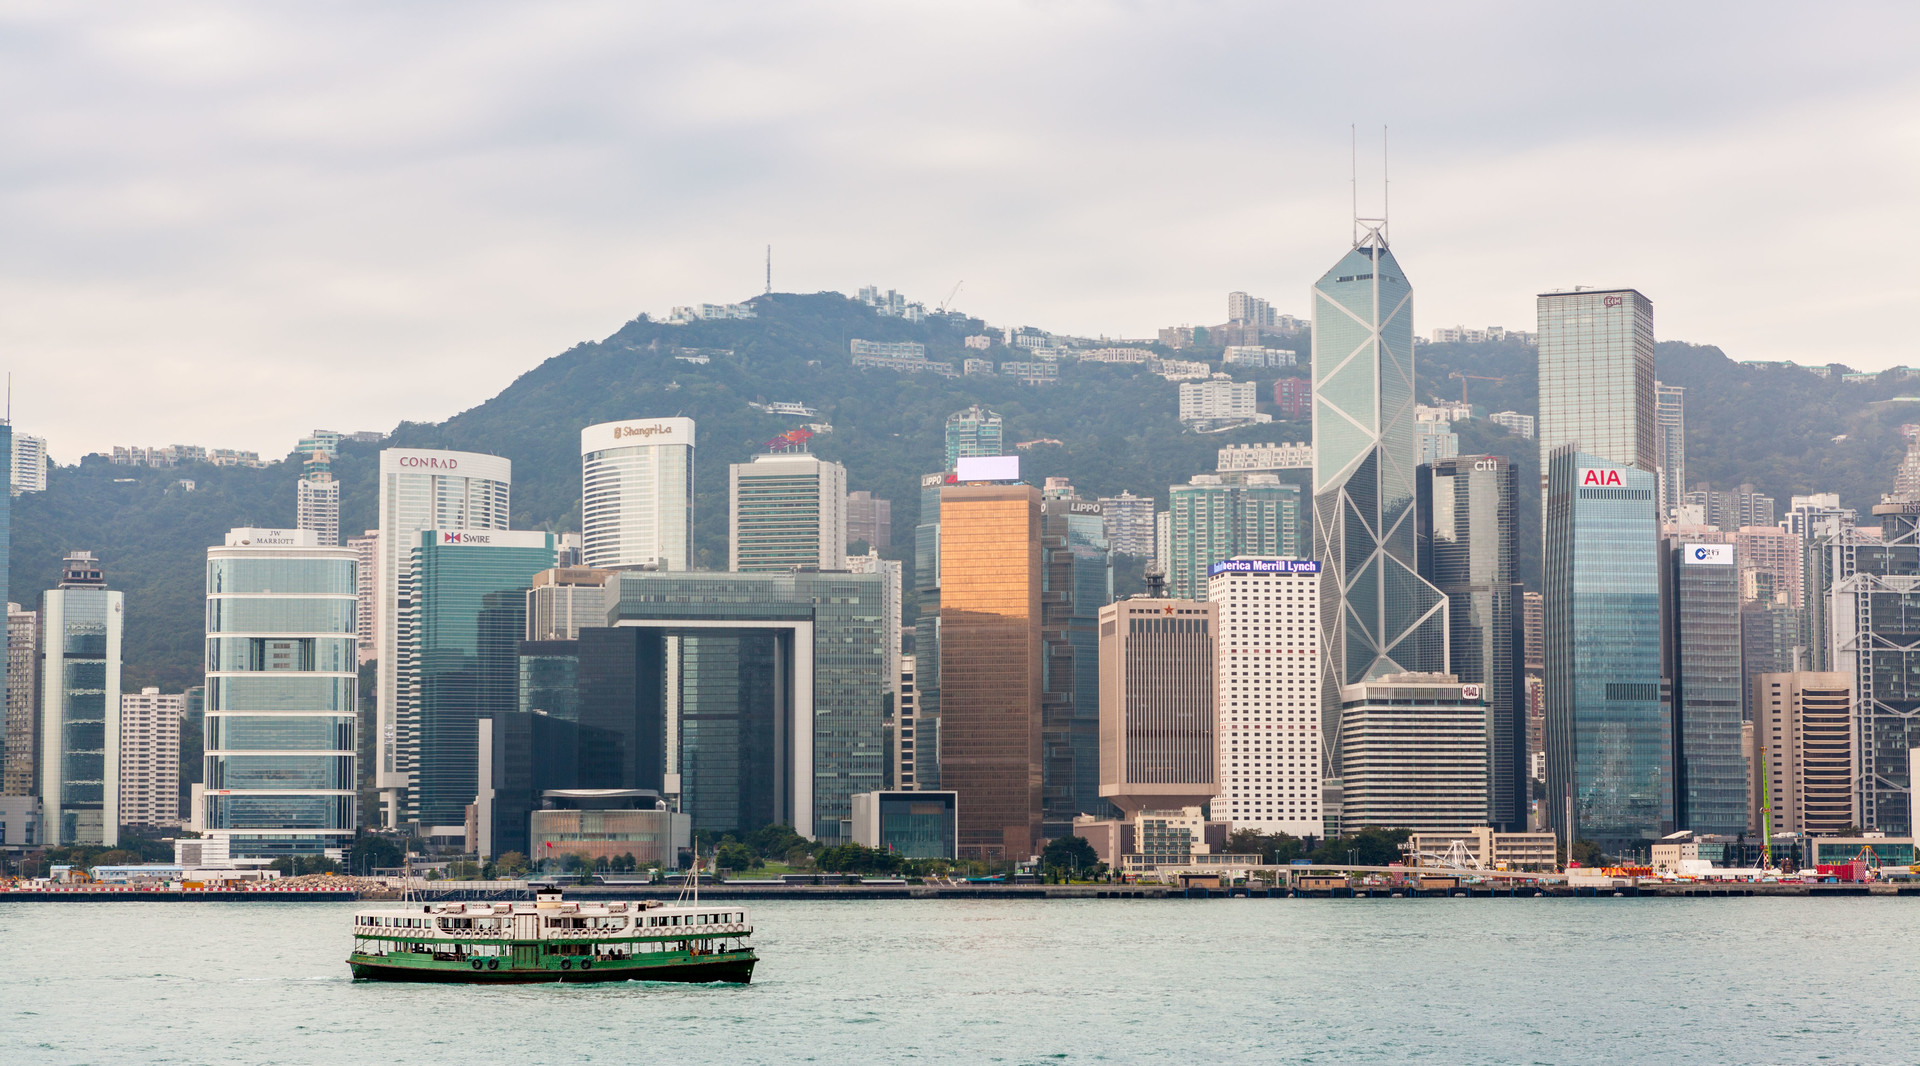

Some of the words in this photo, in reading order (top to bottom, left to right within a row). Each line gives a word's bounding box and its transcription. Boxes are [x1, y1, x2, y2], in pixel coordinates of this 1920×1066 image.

[623, 424, 672, 437] Shangri-La
[400, 457, 458, 470] CONRAD
[1474, 458, 1497, 471] citi
[922, 475, 942, 487] LIPPO
[1584, 470, 1621, 485] AIA
[1070, 503, 1101, 513] LIPPO
[256, 537, 294, 545] MARRIOTT
[1253, 561, 1285, 571] Merrill
[1287, 561, 1316, 573] Lynch
